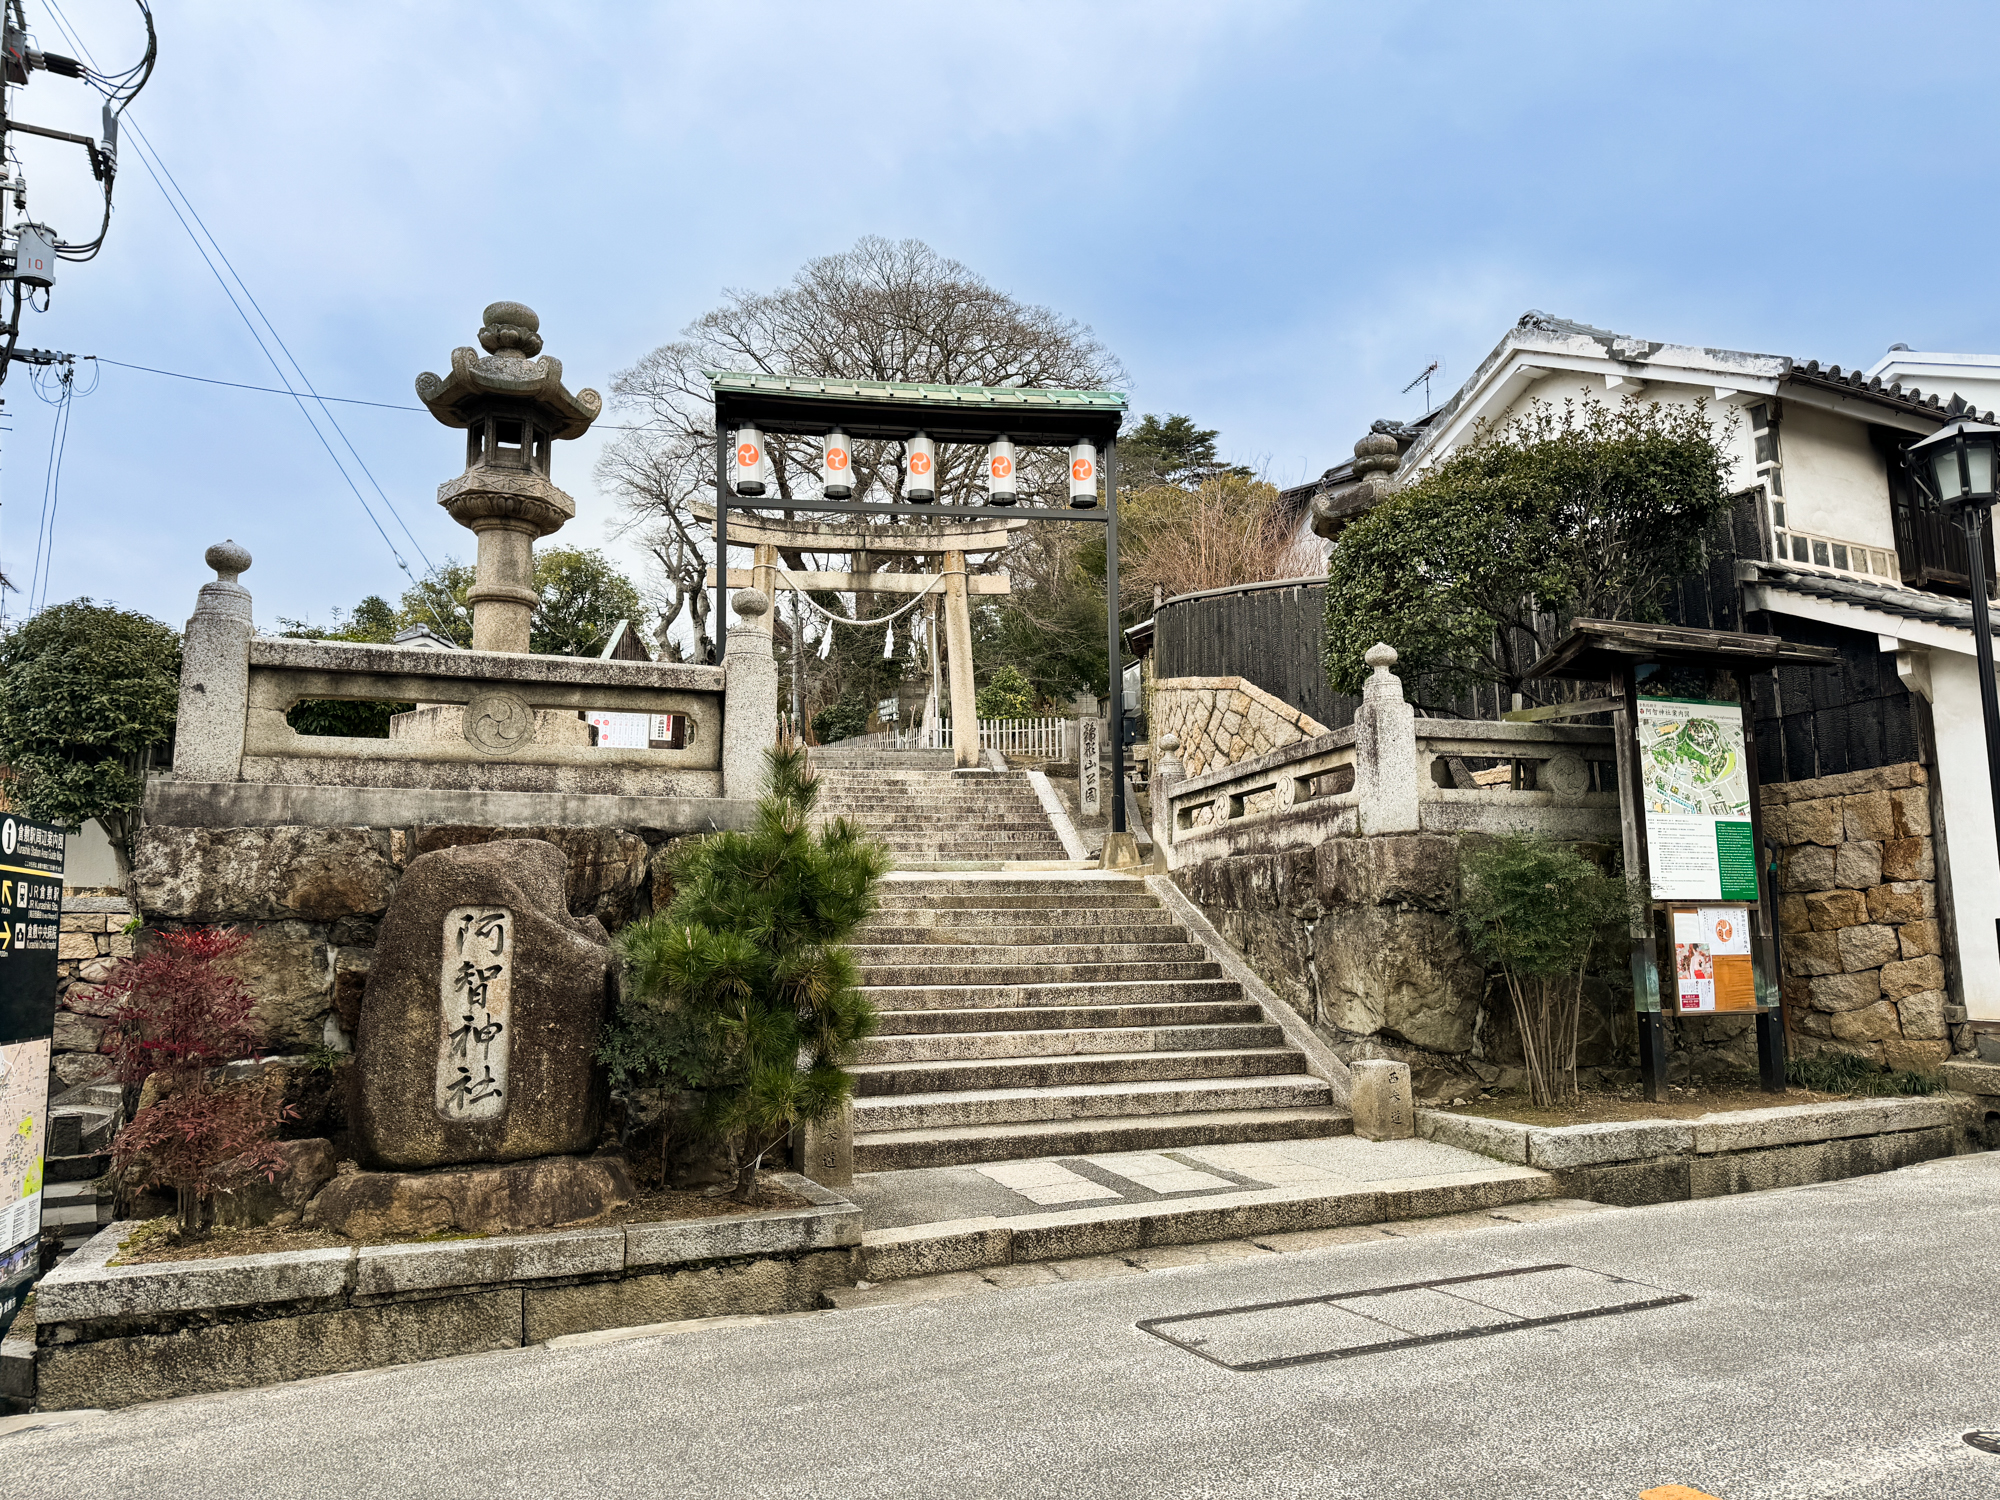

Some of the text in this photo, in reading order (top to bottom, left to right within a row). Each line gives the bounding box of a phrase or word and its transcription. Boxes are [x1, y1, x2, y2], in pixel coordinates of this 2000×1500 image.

[28, 257, 43, 270] 10
[18, 823, 64, 850] 倉敷駅周辺案内図
[29, 884, 60, 901] JR倉敷駅
[27, 924, 57, 940] 倉敷中央病院
[445, 912, 506, 1111] 阿智神社
